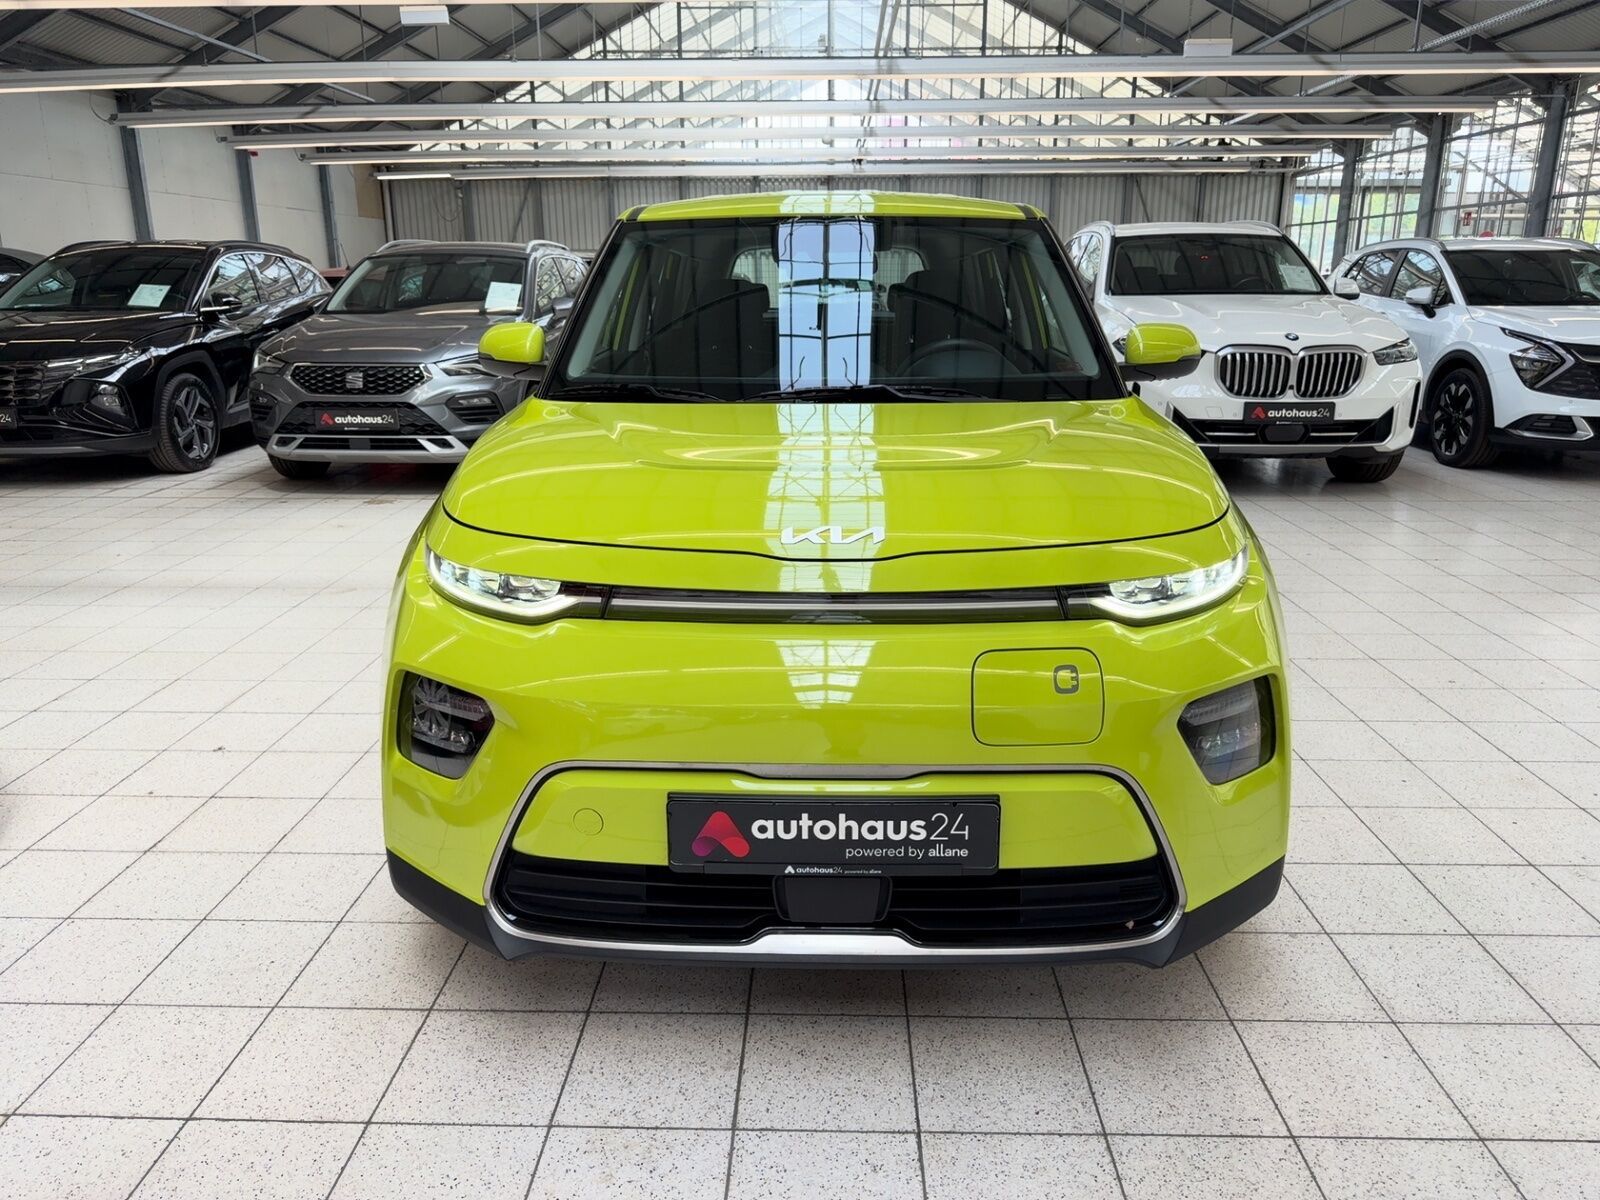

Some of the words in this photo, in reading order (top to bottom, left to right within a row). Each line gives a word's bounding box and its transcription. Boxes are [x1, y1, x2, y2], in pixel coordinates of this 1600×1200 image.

[335, 414, 394, 424] autohaus24
[1267, 408, 1330, 418] autohaus24
[780, 525, 886, 545] KIA
[751, 812, 969, 841] autohaus24
[845, 845, 905, 859] powered
[908, 845, 925, 860] by
[928, 844, 969, 858] allane
[796, 866, 842, 874] autohaus24
